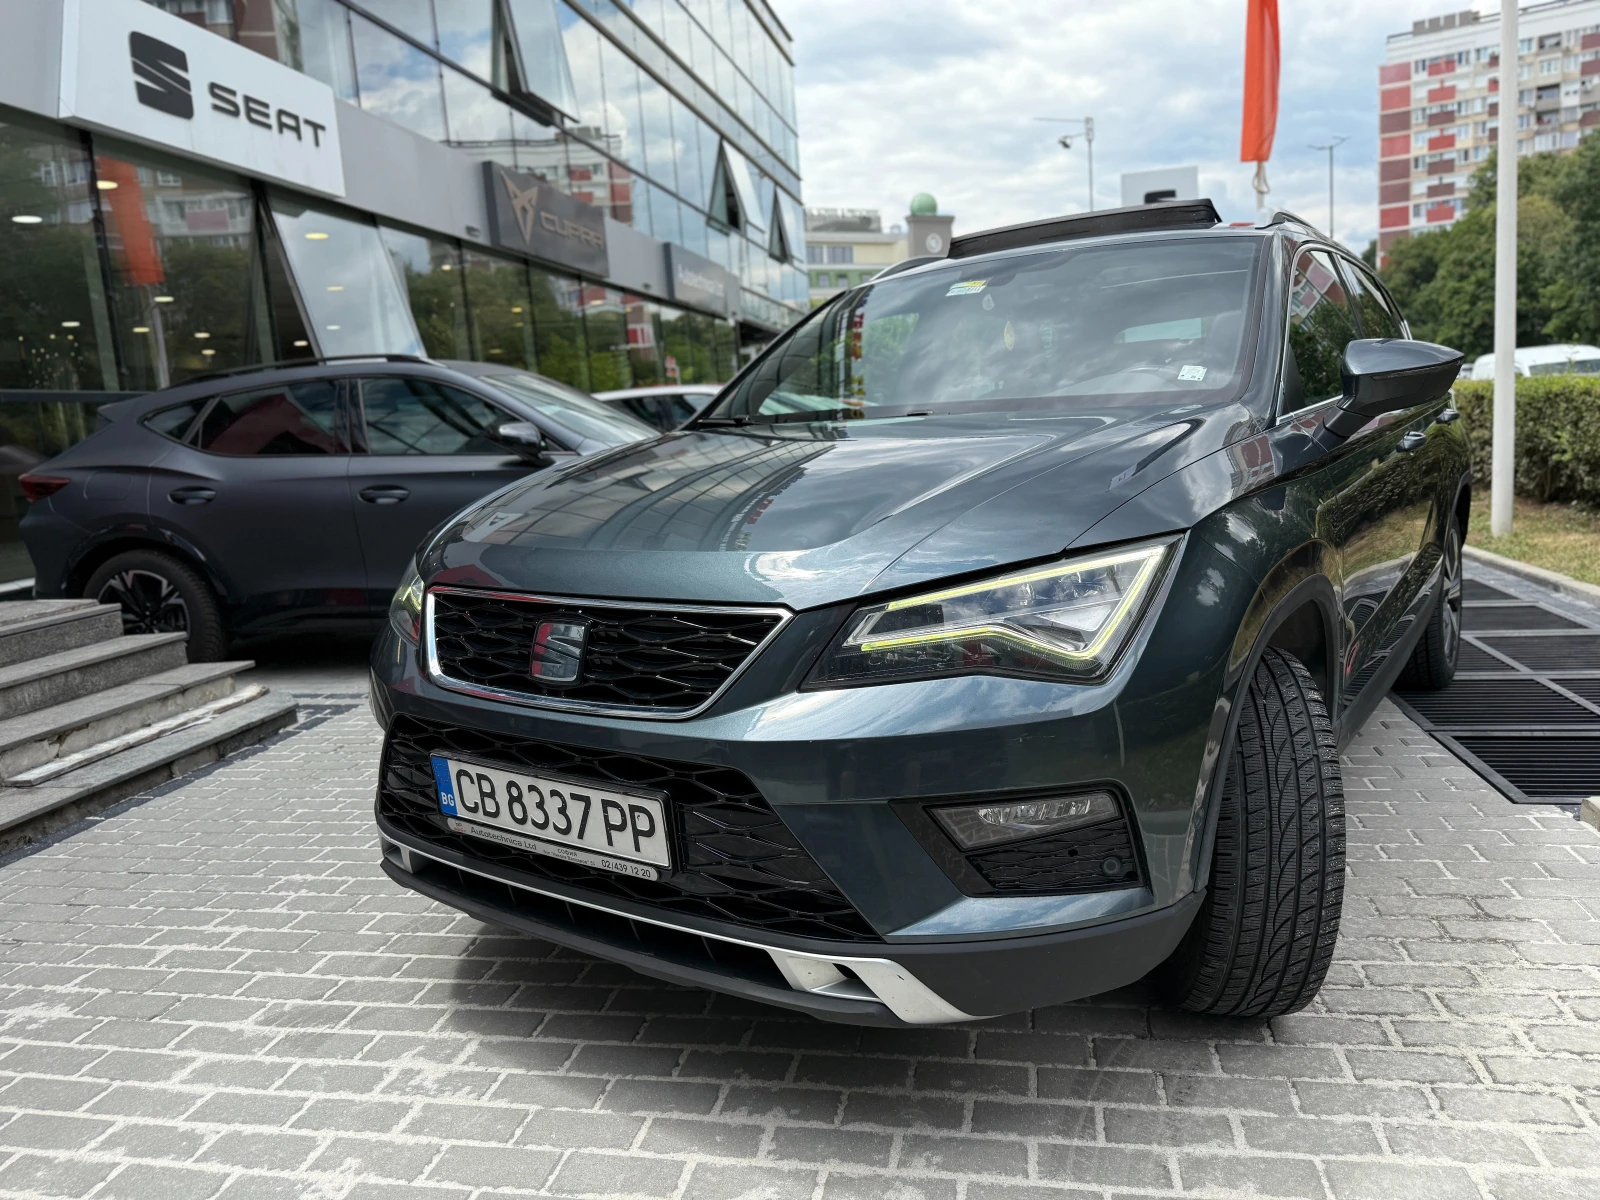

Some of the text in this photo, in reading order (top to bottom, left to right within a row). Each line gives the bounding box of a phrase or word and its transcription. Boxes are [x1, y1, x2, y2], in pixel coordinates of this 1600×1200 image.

[208, 81, 326, 148] SEAT
[441, 792, 455, 807] BG
[455, 769, 656, 852] CB 8337 PP
[471, 826, 522, 847] Autotechnica
[524, 840, 537, 851] Ltd
[601, 859, 652, 878] 02/439 12 20
